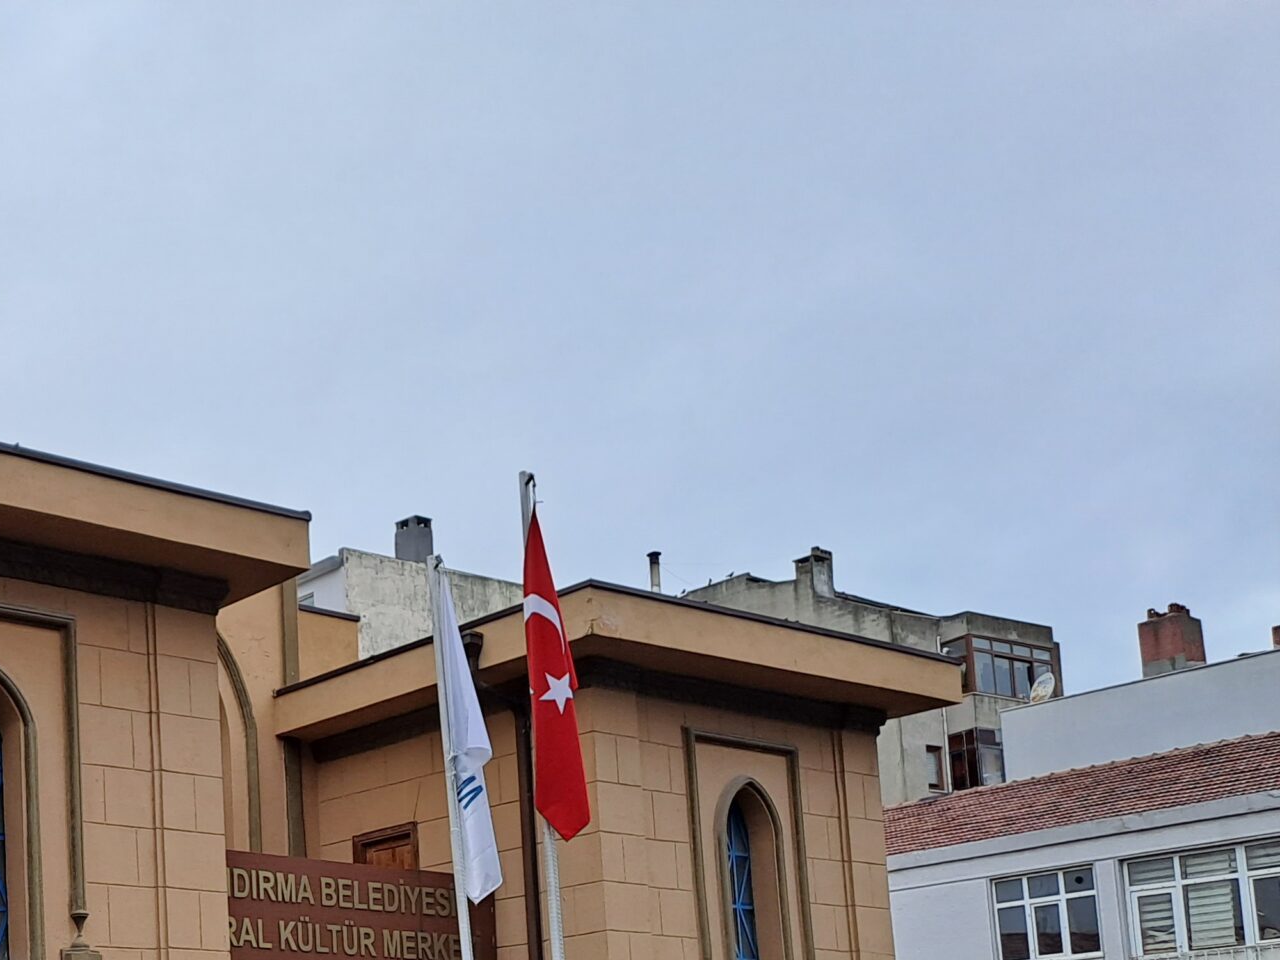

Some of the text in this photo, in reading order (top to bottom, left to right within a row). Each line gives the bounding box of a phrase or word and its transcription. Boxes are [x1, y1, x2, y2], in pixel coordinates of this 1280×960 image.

[227, 867, 457, 917] DIRMA BELEDİYESİ
[279, 916, 377, 958] KÜLTÜR
